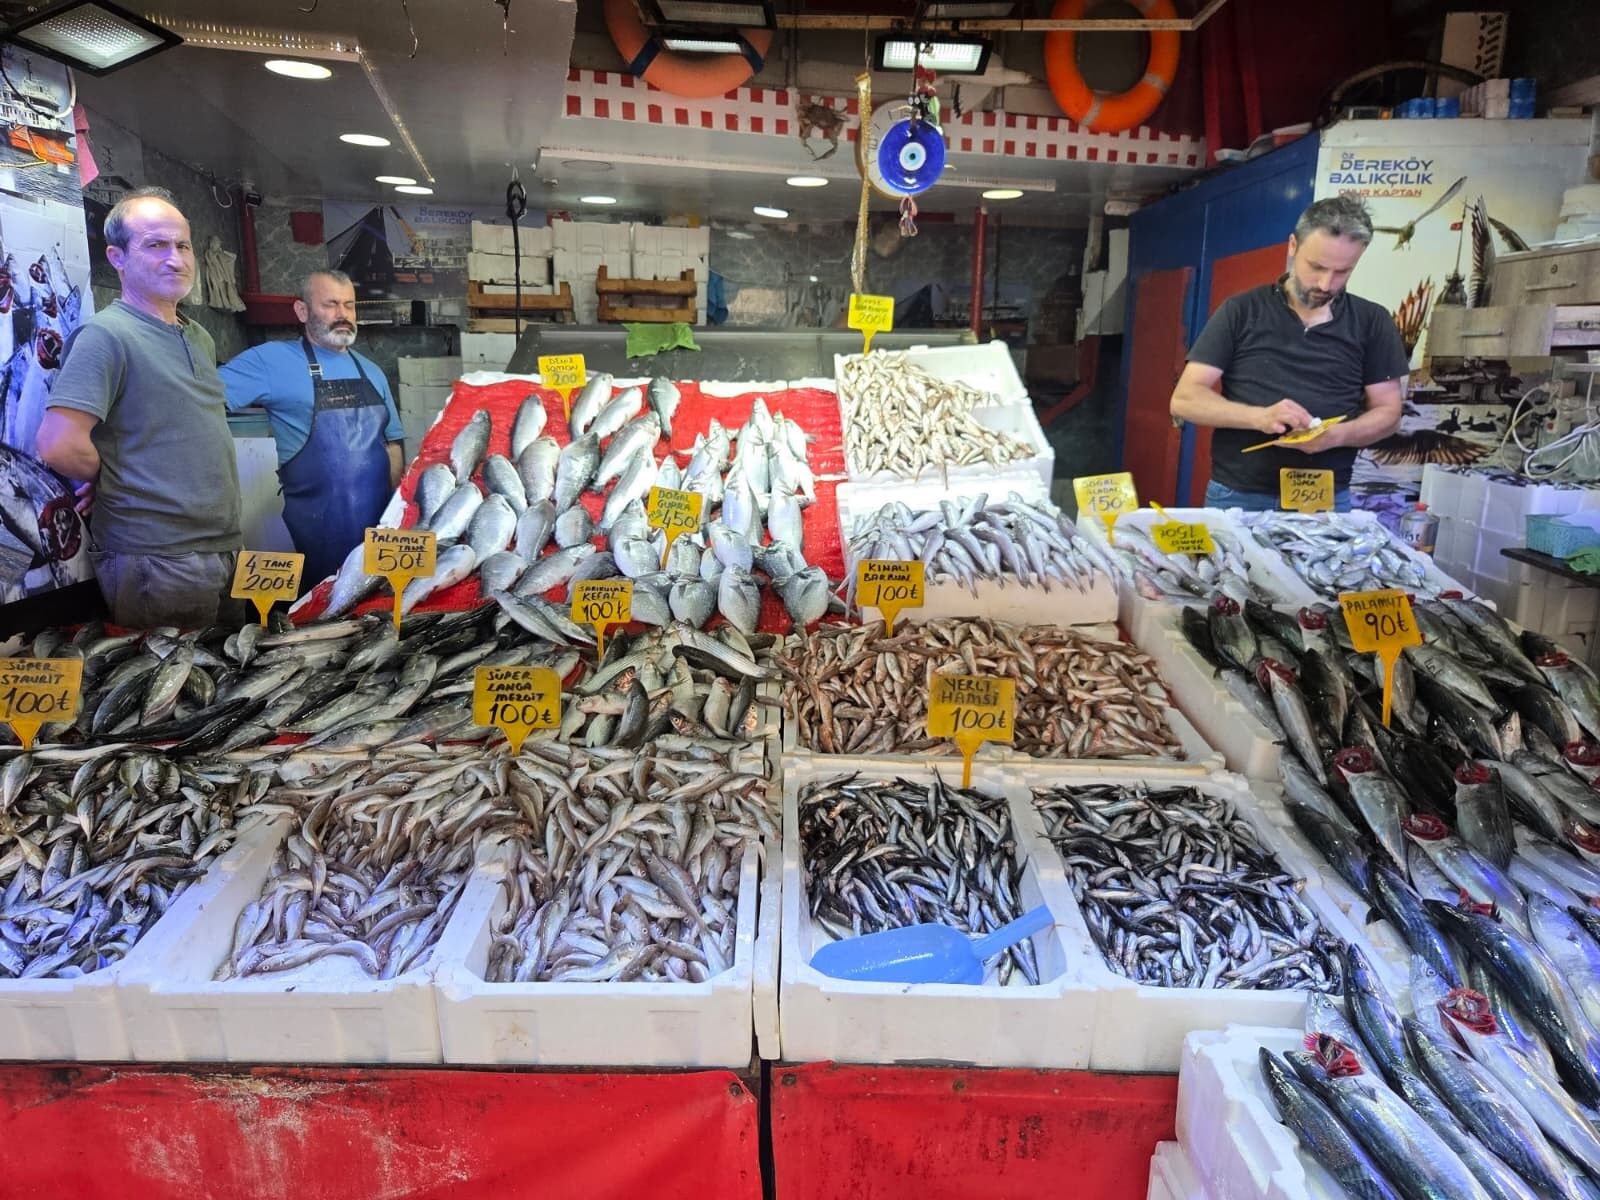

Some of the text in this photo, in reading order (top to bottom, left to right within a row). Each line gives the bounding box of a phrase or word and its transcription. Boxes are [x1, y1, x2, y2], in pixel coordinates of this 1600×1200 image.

[1340, 156, 1434, 171] DEREKÖY
[1329, 172, 1433, 187] BALIKÇILIK
[1373, 188, 1422, 198] KAPTAN
[370, 531, 430, 545] PALAMUT
[245, 555, 294, 574] 4 TANE
[243, 574, 295, 591] 200₺
[582, 592, 619, 601] KEFAL
[1345, 596, 1404, 613] PALAMUT
[487, 669, 532, 680] SÜPER
